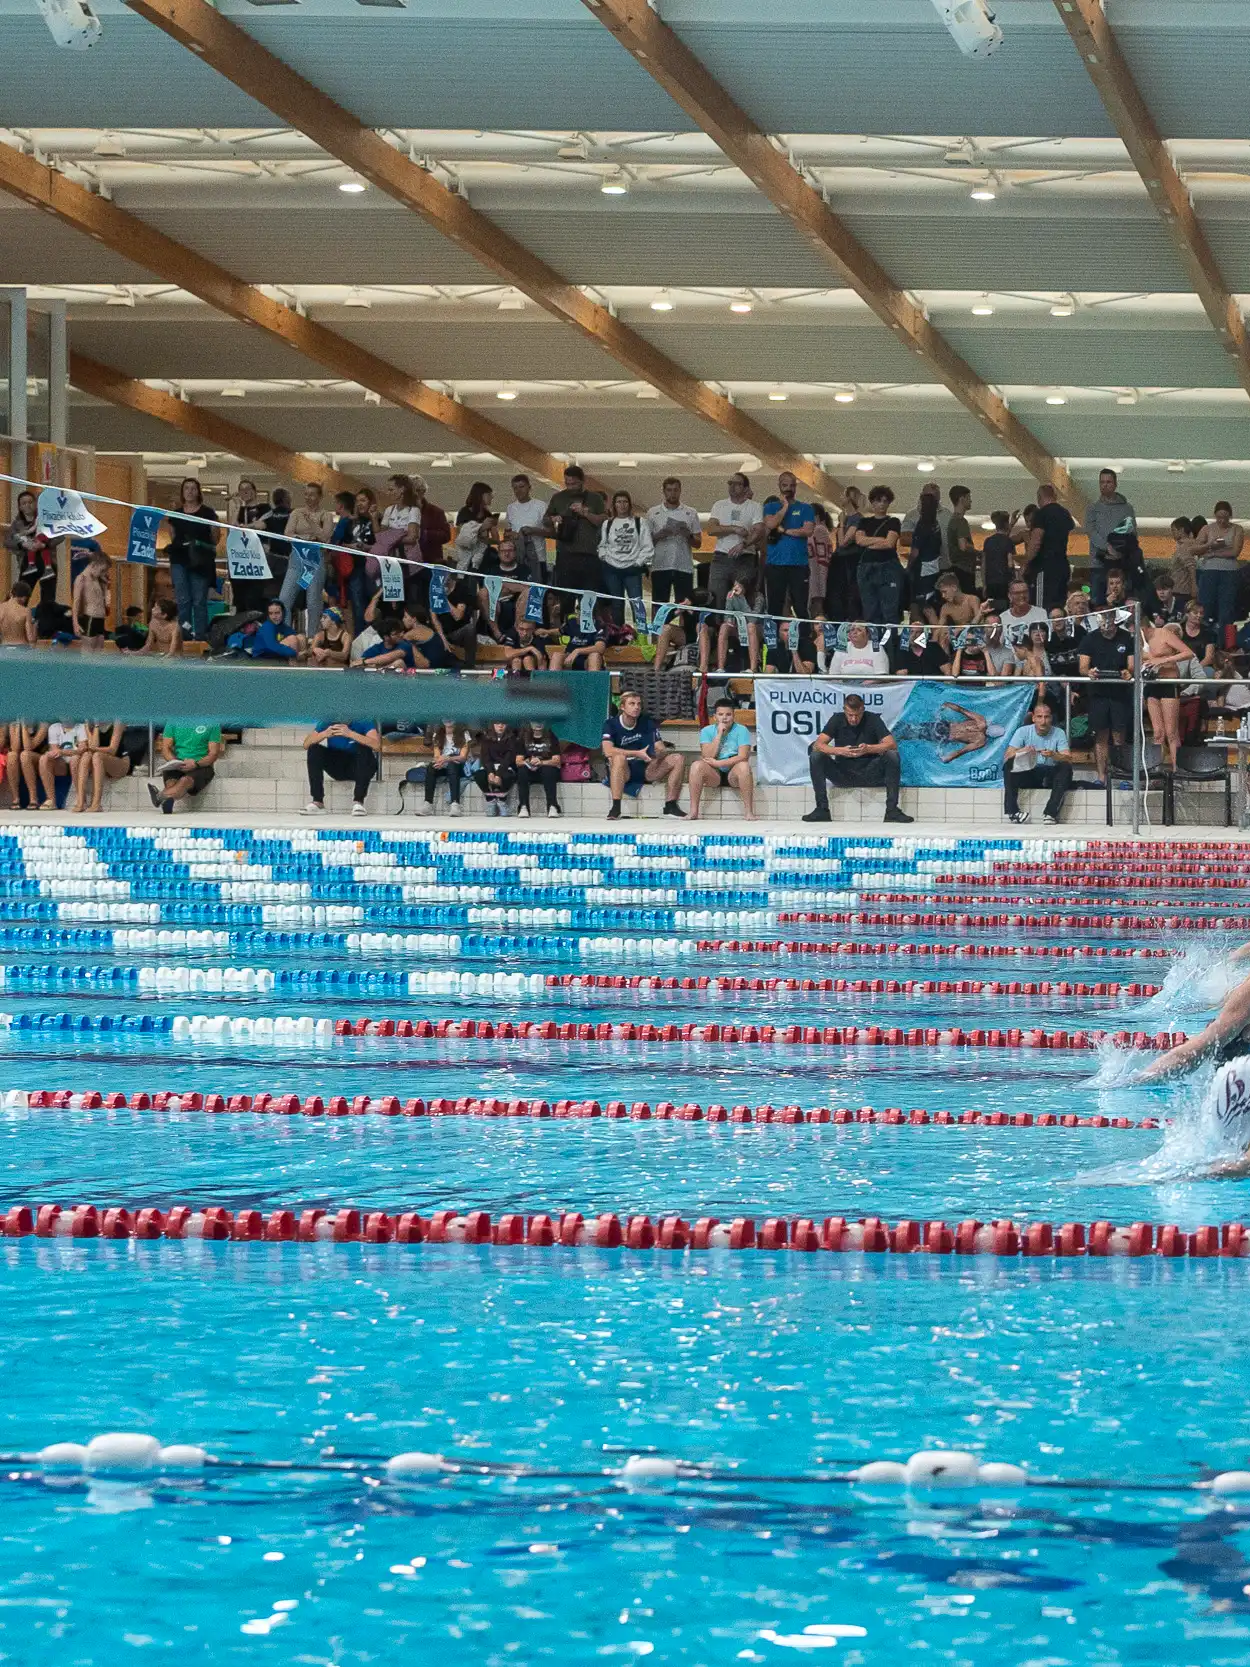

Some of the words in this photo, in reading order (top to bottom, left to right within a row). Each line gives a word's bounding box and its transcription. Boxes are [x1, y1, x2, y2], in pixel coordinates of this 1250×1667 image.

[43, 522, 94, 535] Zadar
[232, 561, 264, 577] Zadar
[770, 689, 837, 705] PLIVAČKI
